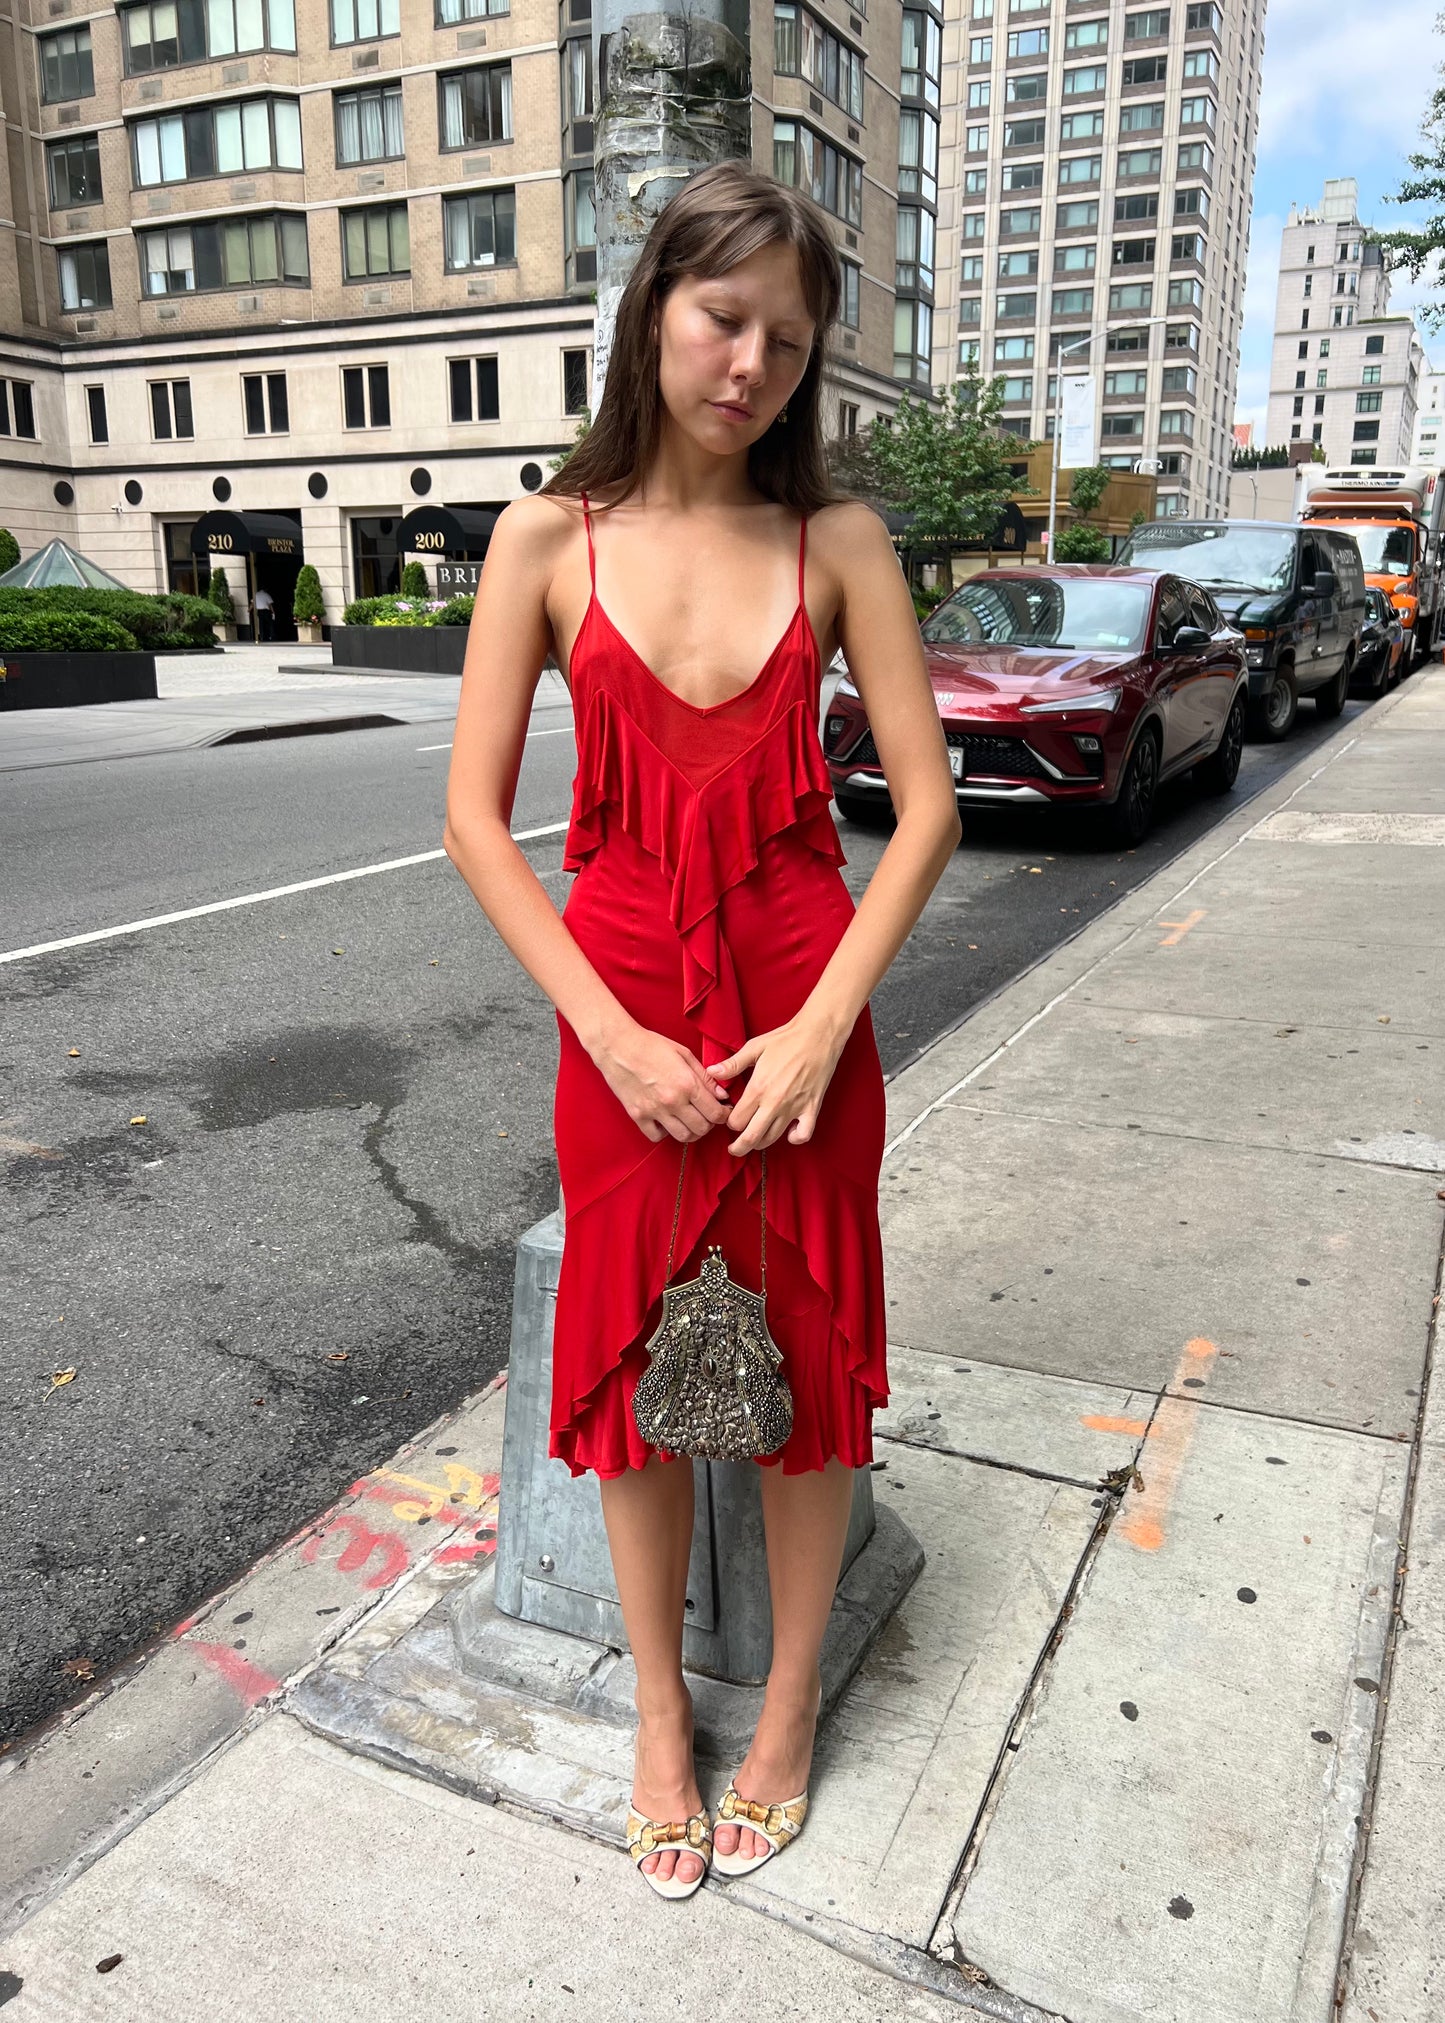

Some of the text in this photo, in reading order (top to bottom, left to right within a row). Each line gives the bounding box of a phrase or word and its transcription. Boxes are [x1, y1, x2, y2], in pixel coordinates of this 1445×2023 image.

[207, 533, 233, 550] 210
[267, 537, 294, 548] BRISTOL
[415, 531, 445, 550] 200
[271, 545, 292, 553] PLAZA
[440, 567, 477, 583] BRI
